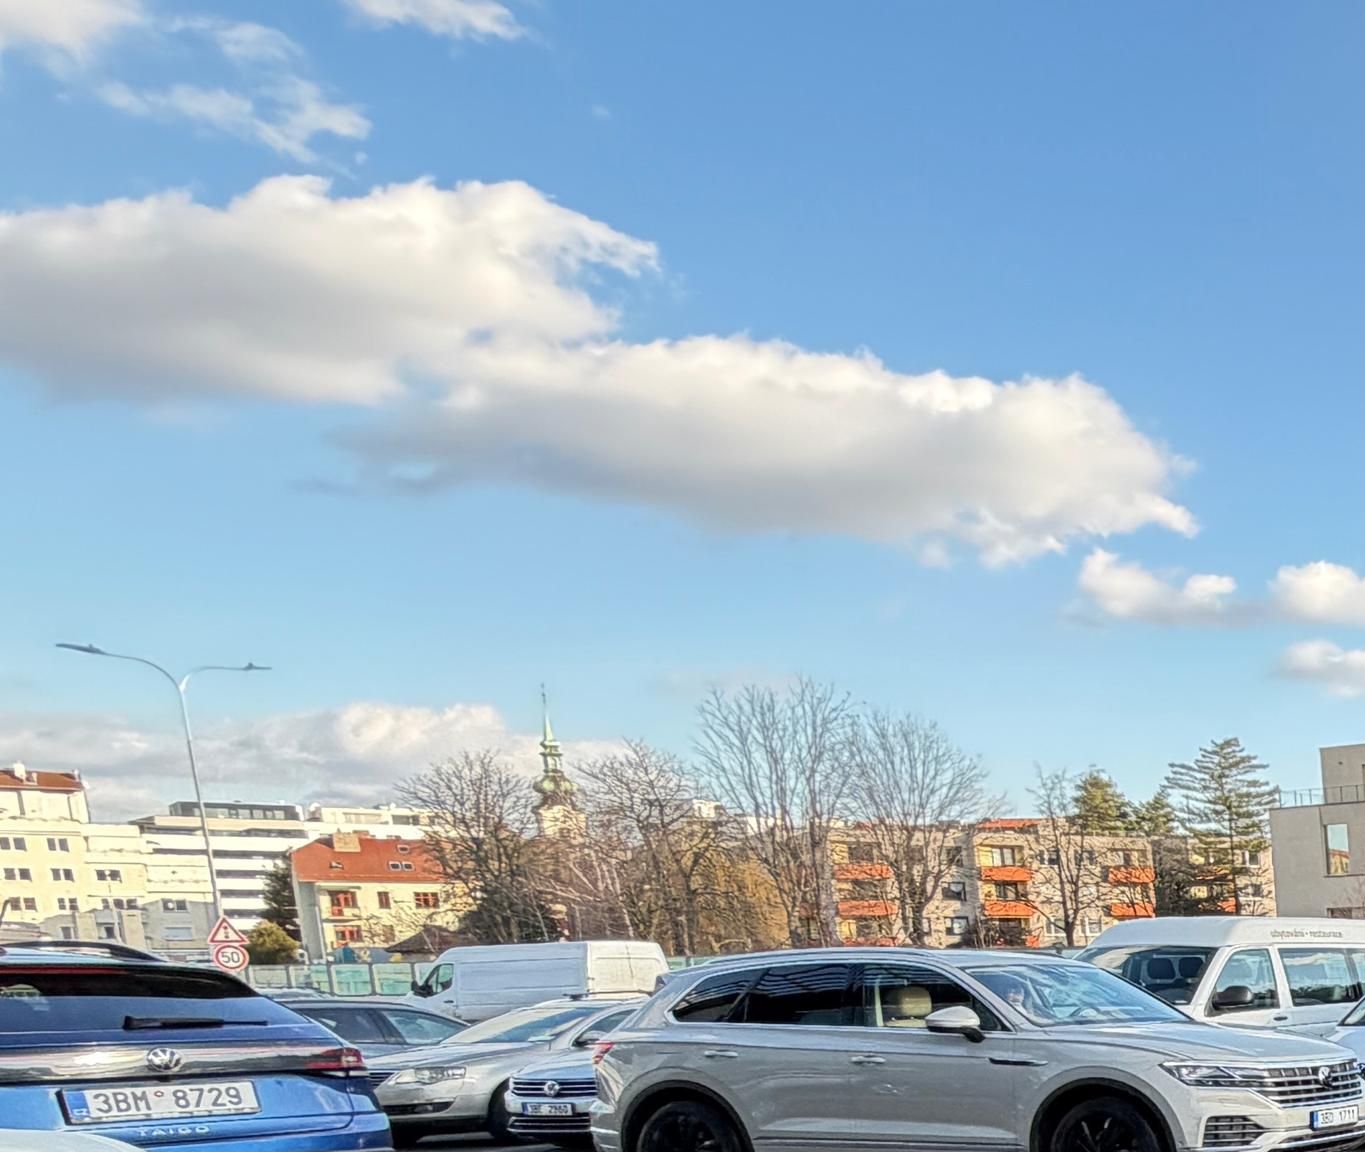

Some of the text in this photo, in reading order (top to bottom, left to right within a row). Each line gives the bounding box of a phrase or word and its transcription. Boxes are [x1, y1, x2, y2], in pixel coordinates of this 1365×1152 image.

[220, 951, 241, 963] 50
[93, 1086, 242, 1114] 3BM 8729
[136, 1125, 211, 1136] TAIGO
